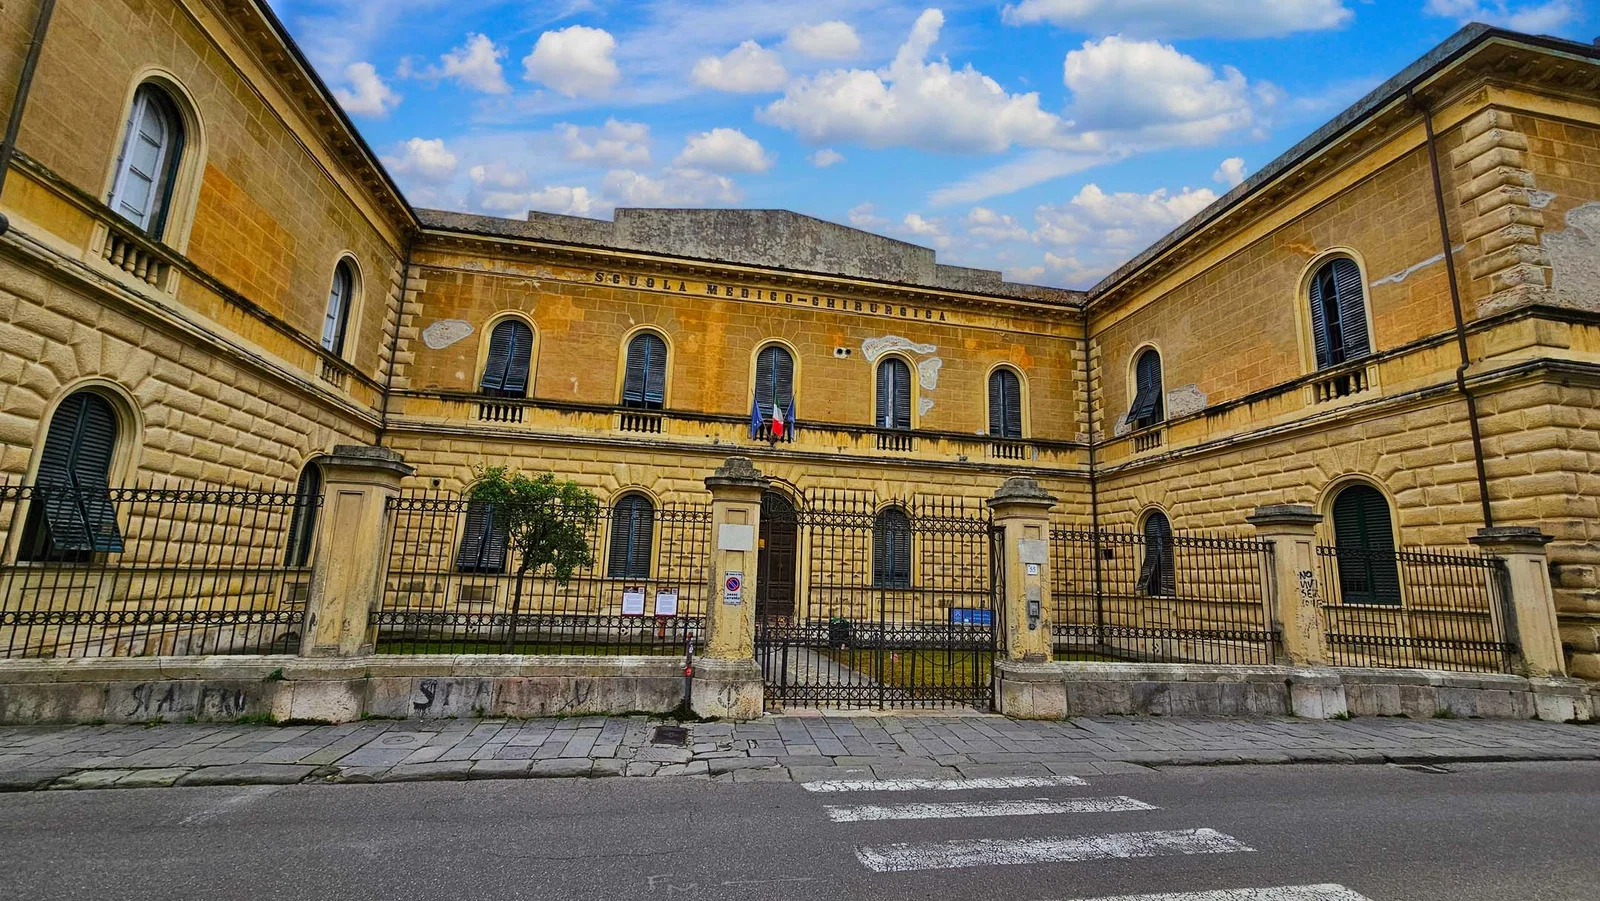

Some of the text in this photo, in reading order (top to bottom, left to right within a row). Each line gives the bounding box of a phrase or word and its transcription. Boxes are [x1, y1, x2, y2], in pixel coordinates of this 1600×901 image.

[594, 272, 946, 322] SCUOLA MEDICO-CHIRURGICA
[1299, 571, 1313, 580] NO
